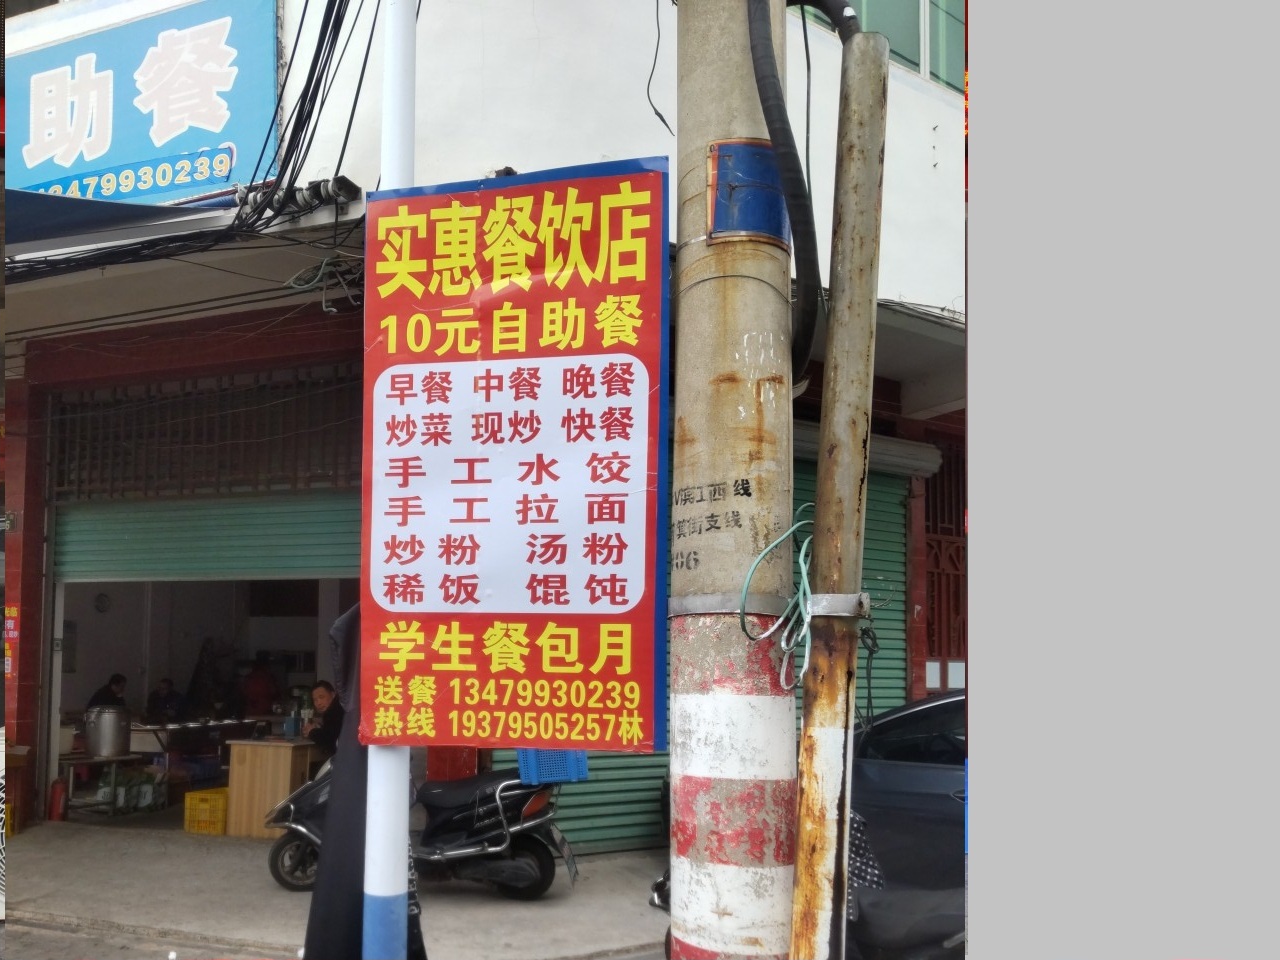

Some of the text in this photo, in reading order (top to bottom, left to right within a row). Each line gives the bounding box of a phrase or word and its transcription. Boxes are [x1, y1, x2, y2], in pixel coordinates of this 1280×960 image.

[22, 15, 239, 170] 助餐
[39, 152, 231, 199] 479930239
[375, 180, 651, 299] 实惠餐饮店
[380, 293, 643, 356] 10元自助餐
[385, 361, 636, 405] 早餐 中餐 晚餐
[385, 406, 635, 447] 炒菜 现炒 快餐
[383, 532, 629, 566] 炒粉 汤粉
[382, 573, 630, 606] 稀饭 馄饨
[379, 620, 632, 675] 学生餐包月
[374, 675, 641, 709] 送餐 13479930239
[373, 707, 436, 738] 热线
